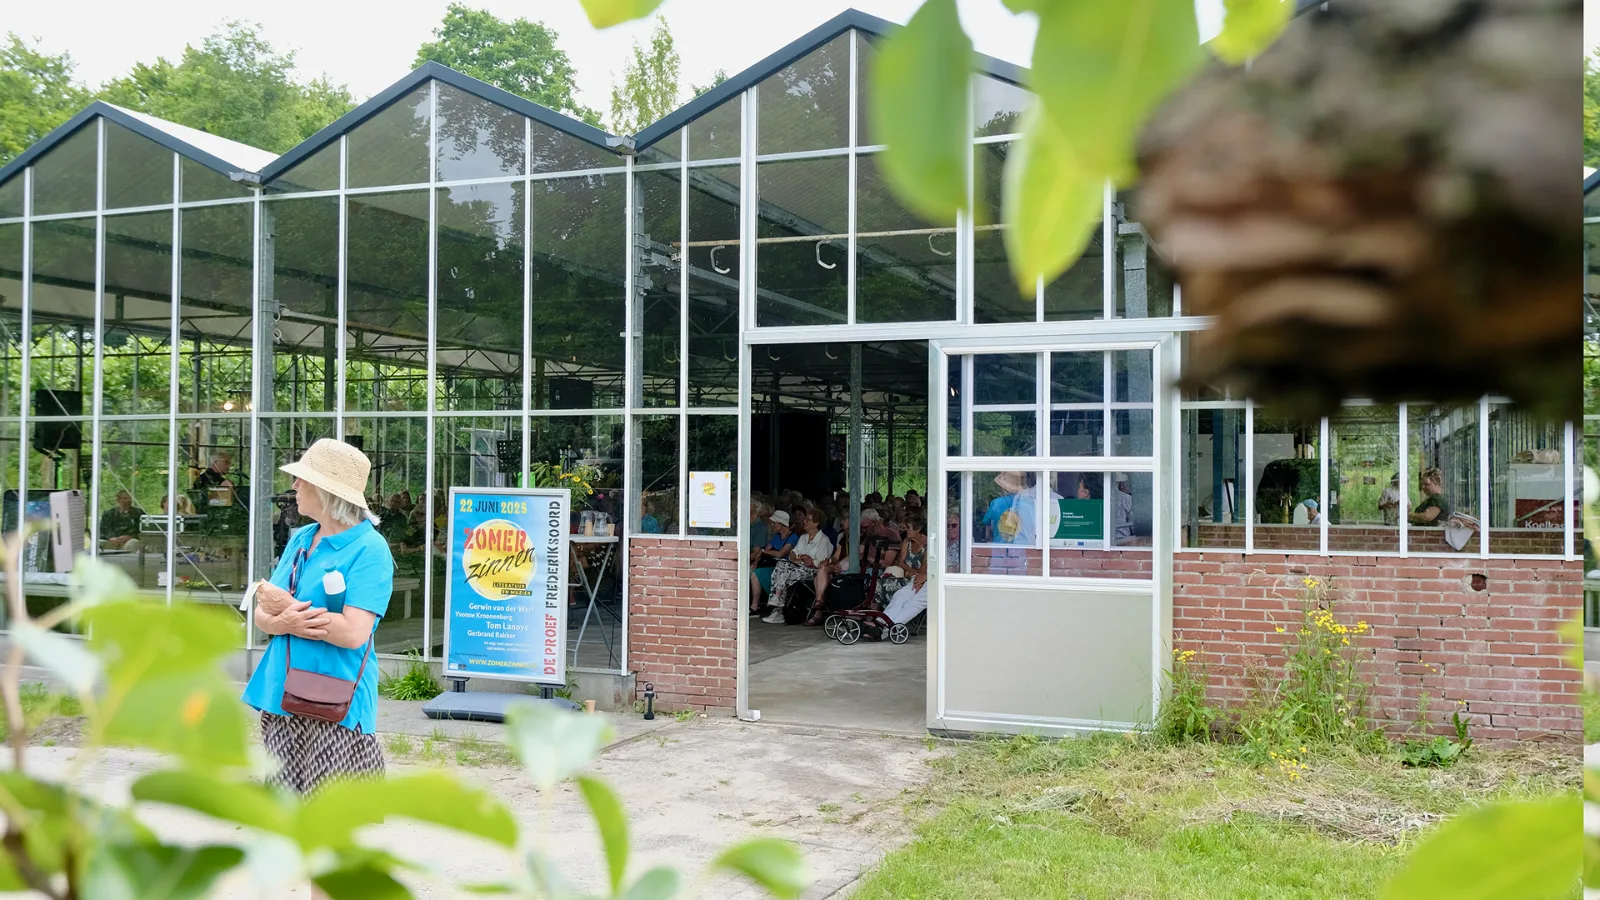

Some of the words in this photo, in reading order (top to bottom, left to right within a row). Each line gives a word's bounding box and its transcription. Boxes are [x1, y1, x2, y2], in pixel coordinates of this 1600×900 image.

[460, 498, 473, 512] 22
[475, 500, 499, 513] JUNI
[501, 501, 527, 514] 2025
[1524, 520, 1565, 528] Koelkas
[463, 528, 527, 552] ZOMER
[545, 501, 561, 609] FREDERIKSOORD
[464, 547, 536, 584] zinnen
[455, 610, 475, 618] Yvonne
[476, 612, 513, 621] Kroonenberg
[486, 621, 501, 630] Tom
[467, 630, 495, 638] Gerbrand
[496, 631, 516, 639] Bakker
[544, 613, 557, 656] PROEF
[469, 658, 538, 669] WWW.ZOMERZINNEN.
[543, 658, 556, 675] DE
